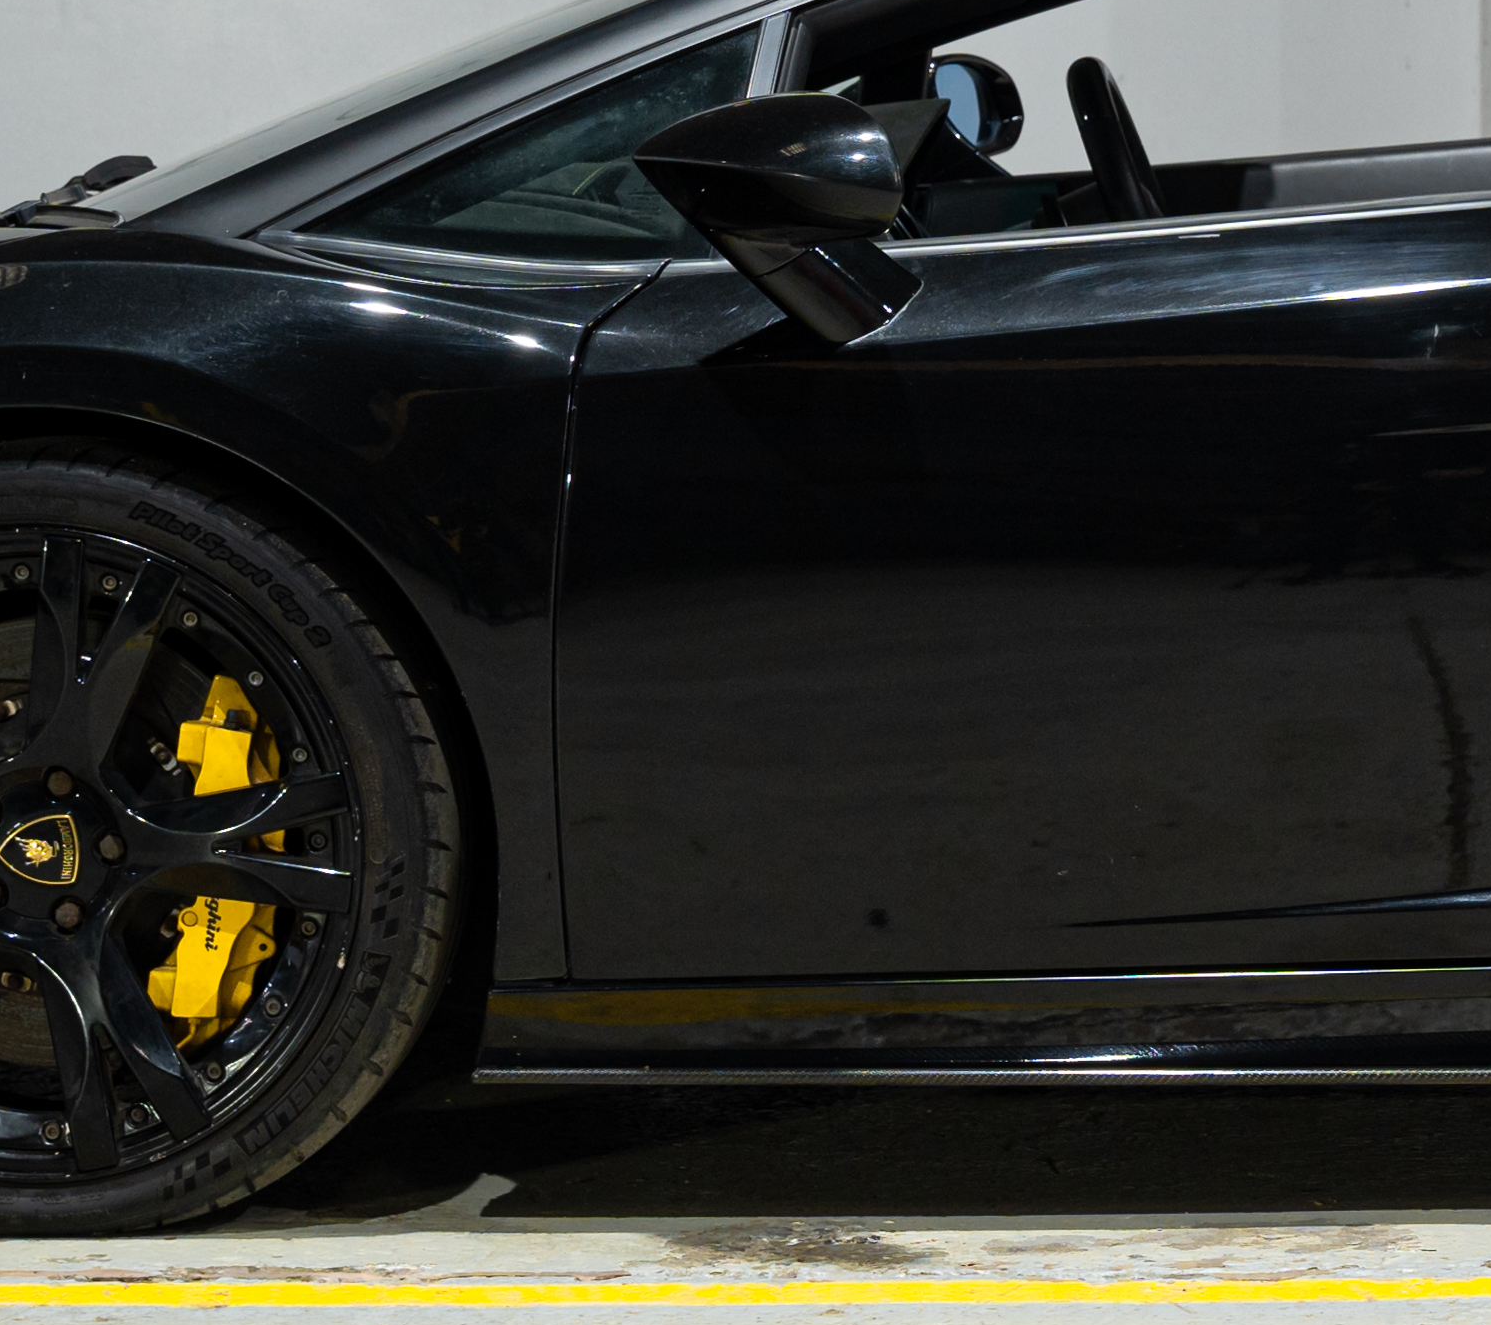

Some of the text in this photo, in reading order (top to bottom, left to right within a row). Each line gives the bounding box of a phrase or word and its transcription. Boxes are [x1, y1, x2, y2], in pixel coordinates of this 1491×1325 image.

[128, 501, 202, 542] Pilot
[194, 532, 273, 587] Sport
[267, 583, 310, 626] Cup
[304, 626, 332, 648] 2
[57, 819, 74, 880] LAMBORGHINI
[243, 993, 372, 1153] MICHELIN
